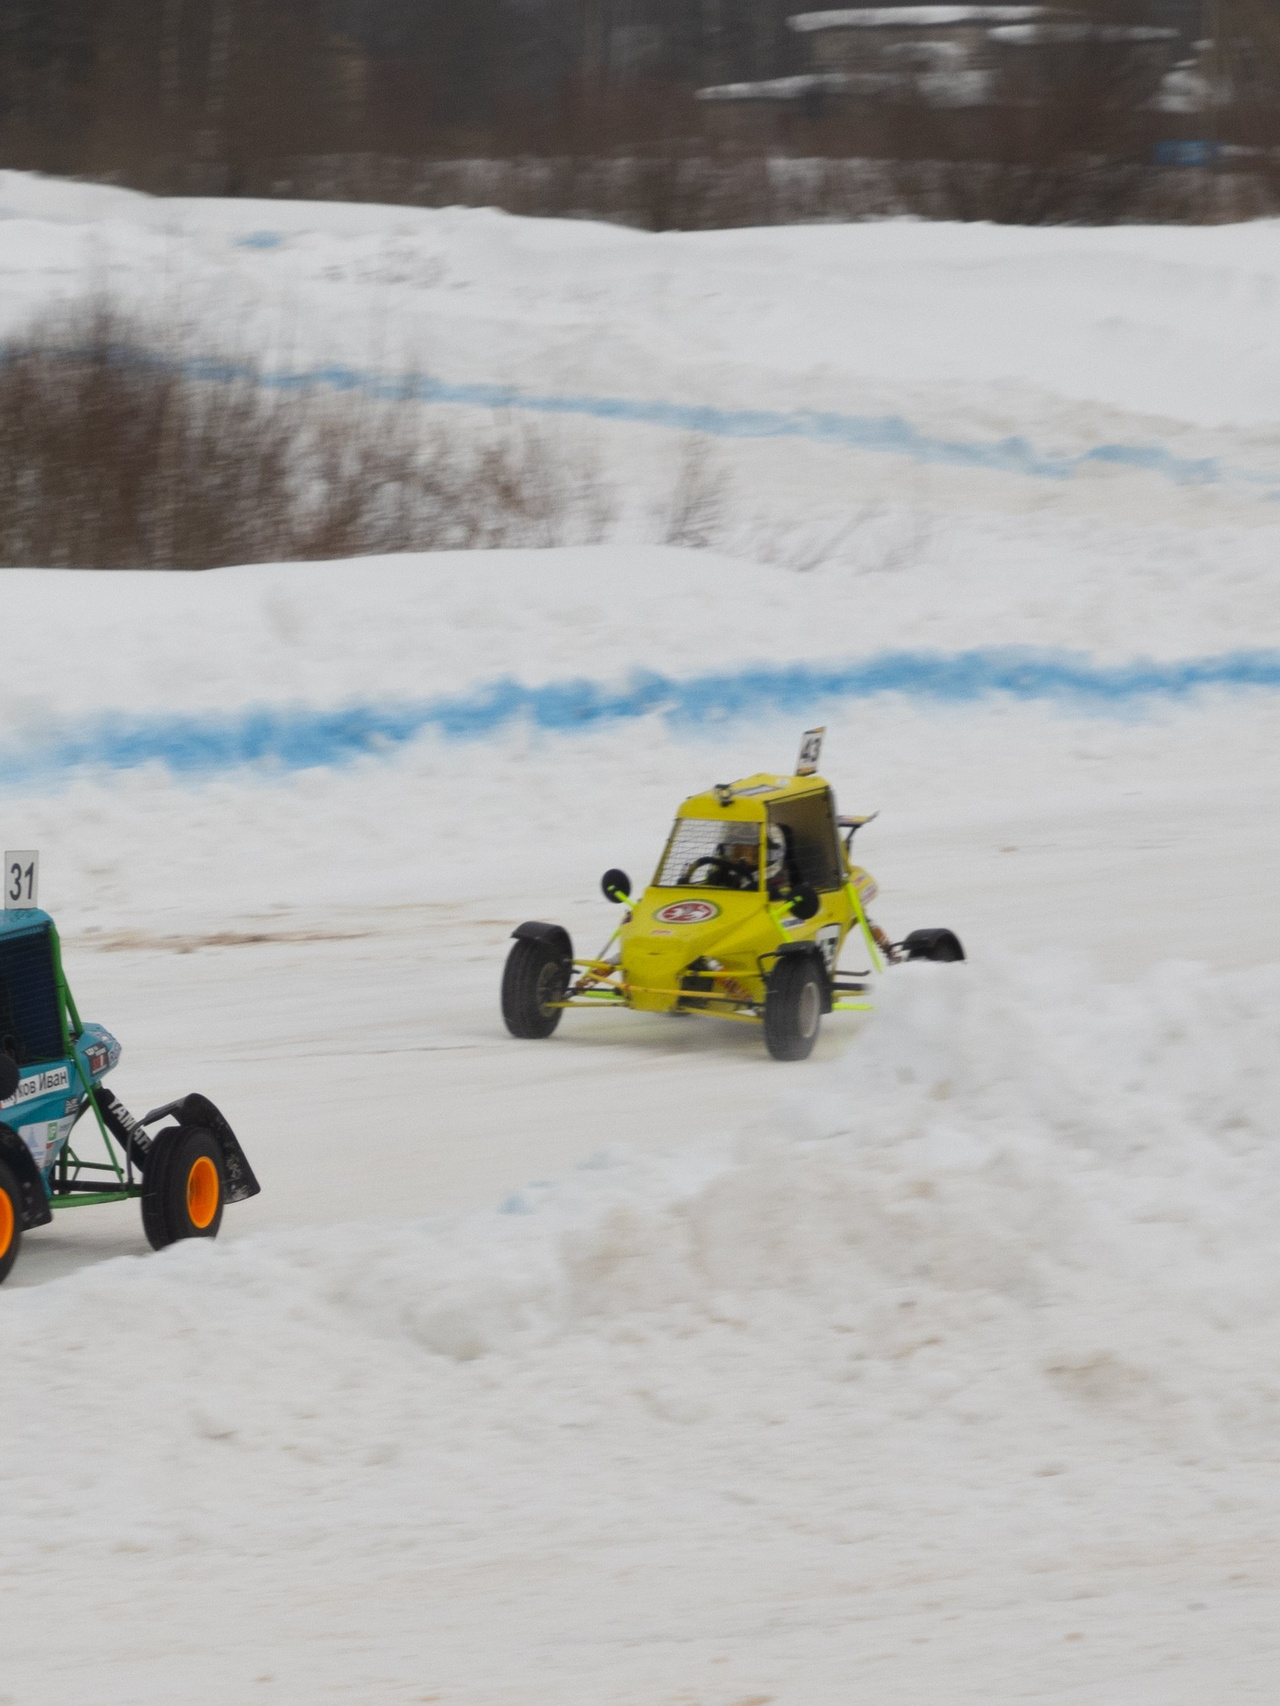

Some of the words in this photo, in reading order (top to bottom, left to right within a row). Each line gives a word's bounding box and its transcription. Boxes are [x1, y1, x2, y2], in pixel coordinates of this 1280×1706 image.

[800, 737, 821, 762] 43
[9, 862, 34, 901] 31
[3, 1080, 37, 1105] уков
[39, 1071, 68, 1092] Иван
[107, 1097, 152, 1154] YAMAH
